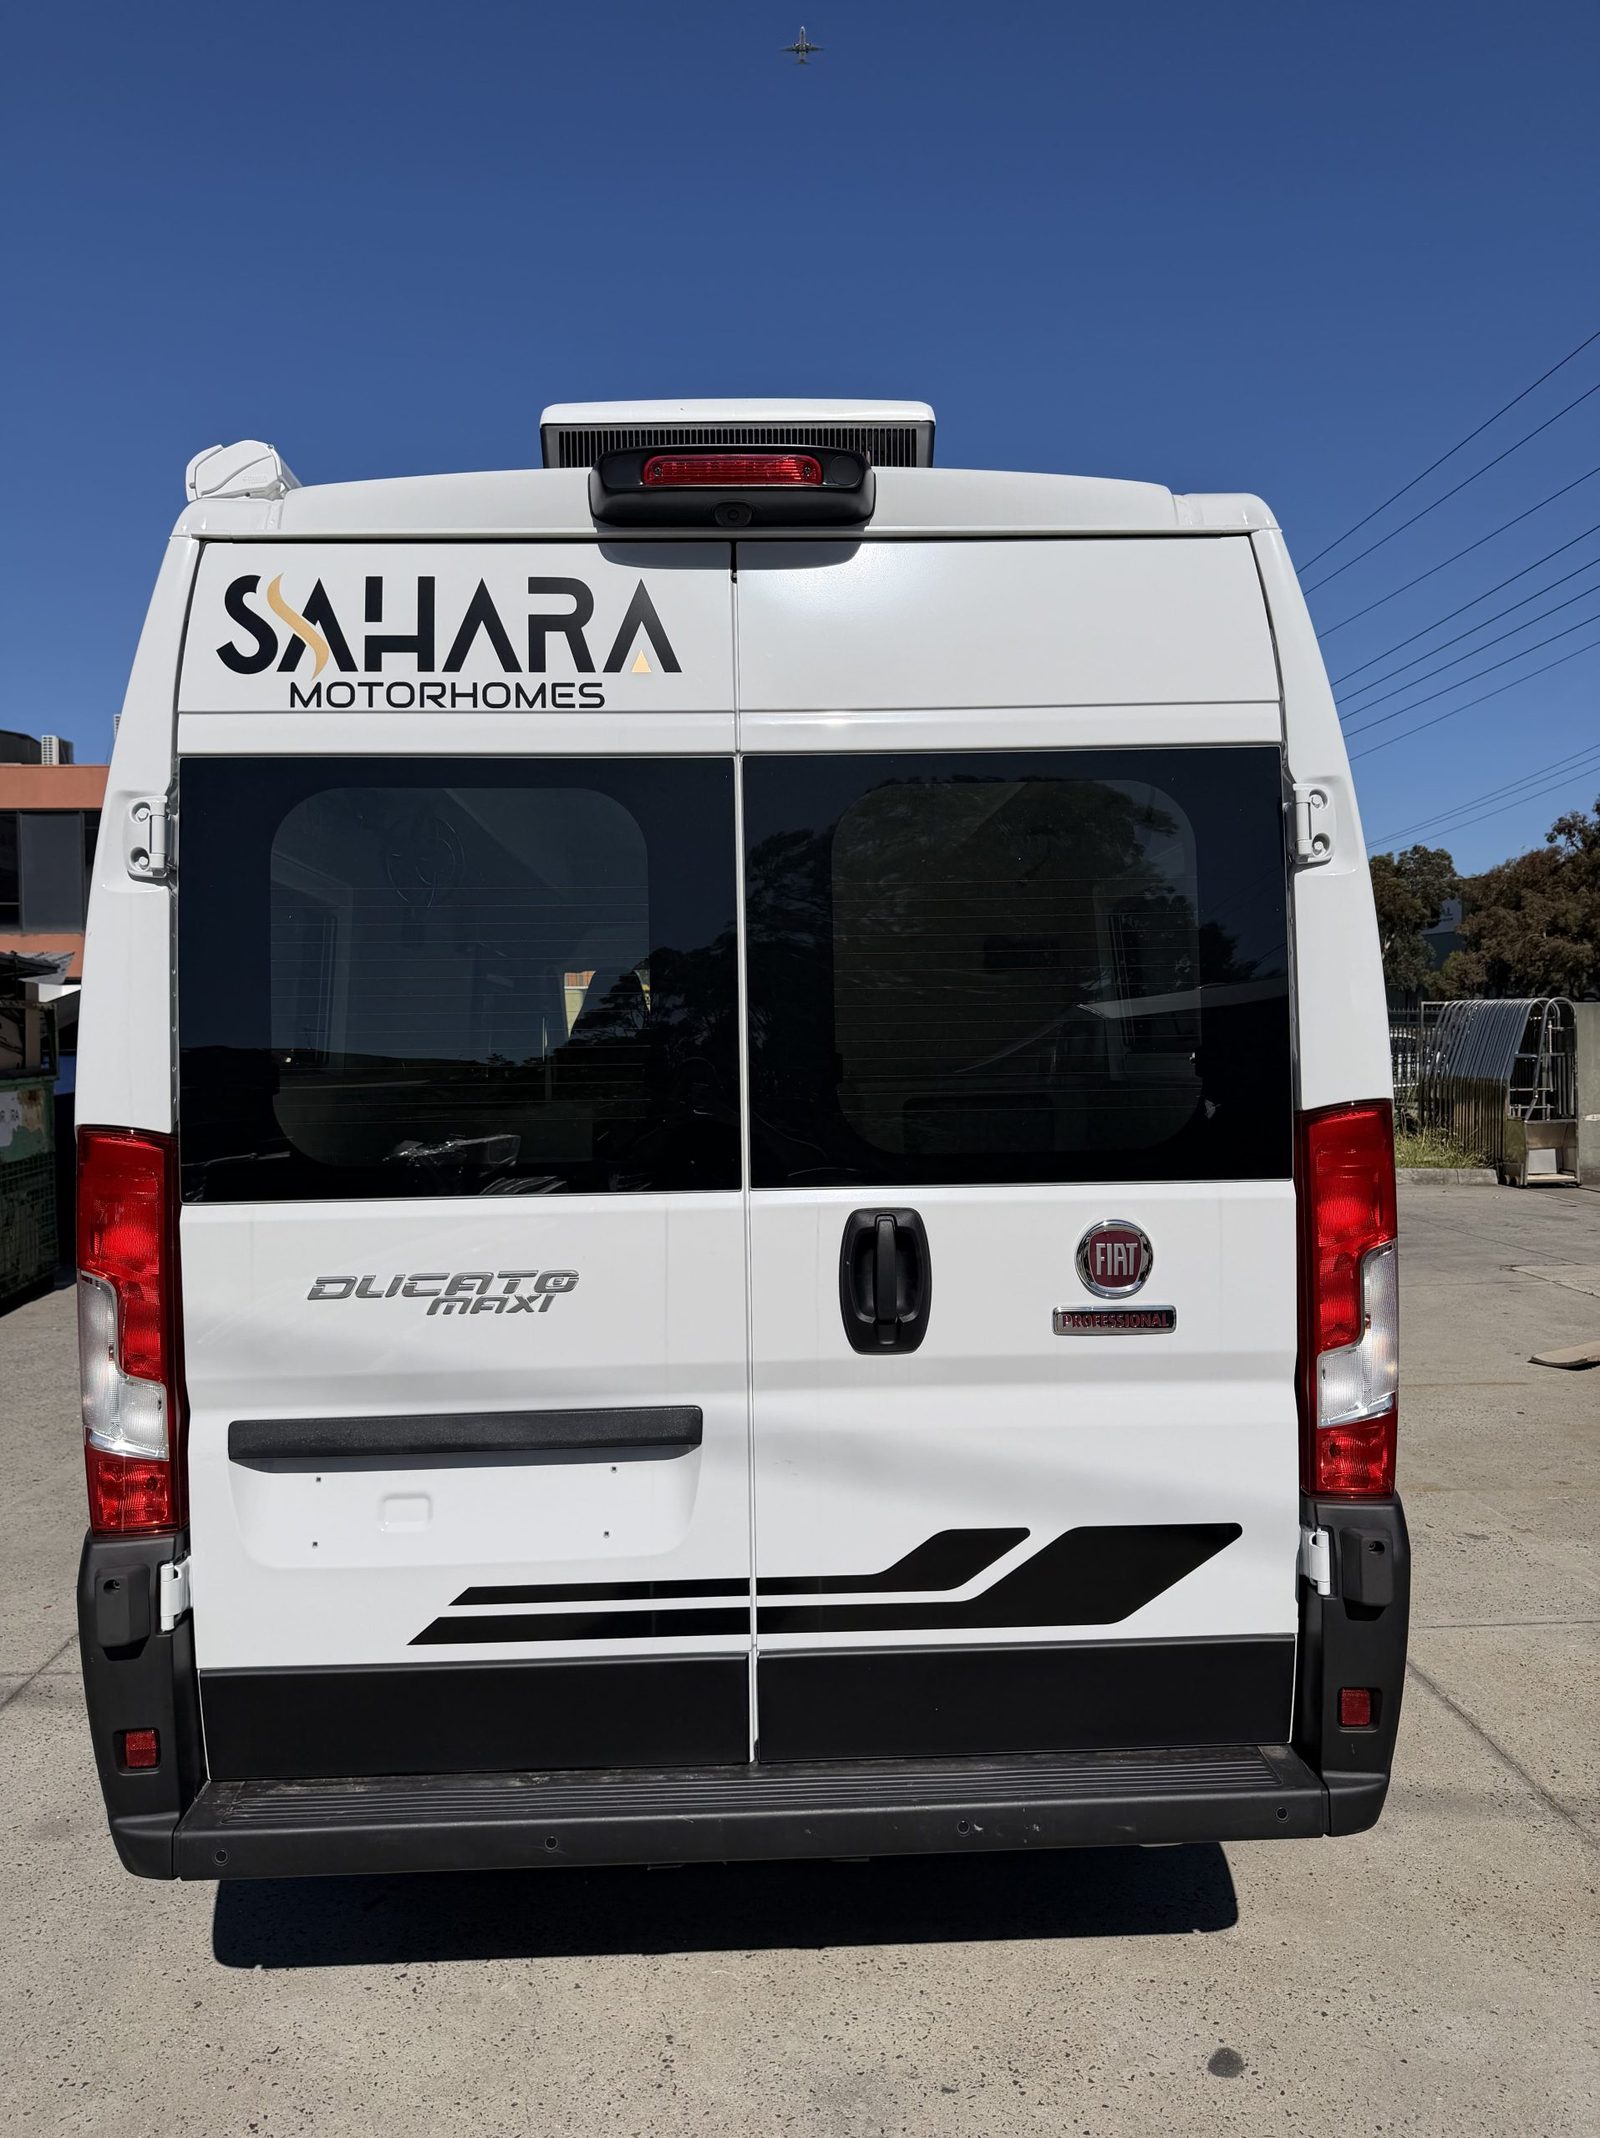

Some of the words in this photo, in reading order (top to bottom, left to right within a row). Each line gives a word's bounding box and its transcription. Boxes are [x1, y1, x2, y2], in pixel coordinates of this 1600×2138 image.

[216, 574, 682, 680] SAHARA
[290, 682, 605, 709] MOTORHOMES
[1096, 1243, 1138, 1276] FIAT
[307, 1271, 580, 1299] DUCATO
[427, 1295, 555, 1316] MAXI
[1063, 1313, 1169, 1328] PROFESSIONAL
